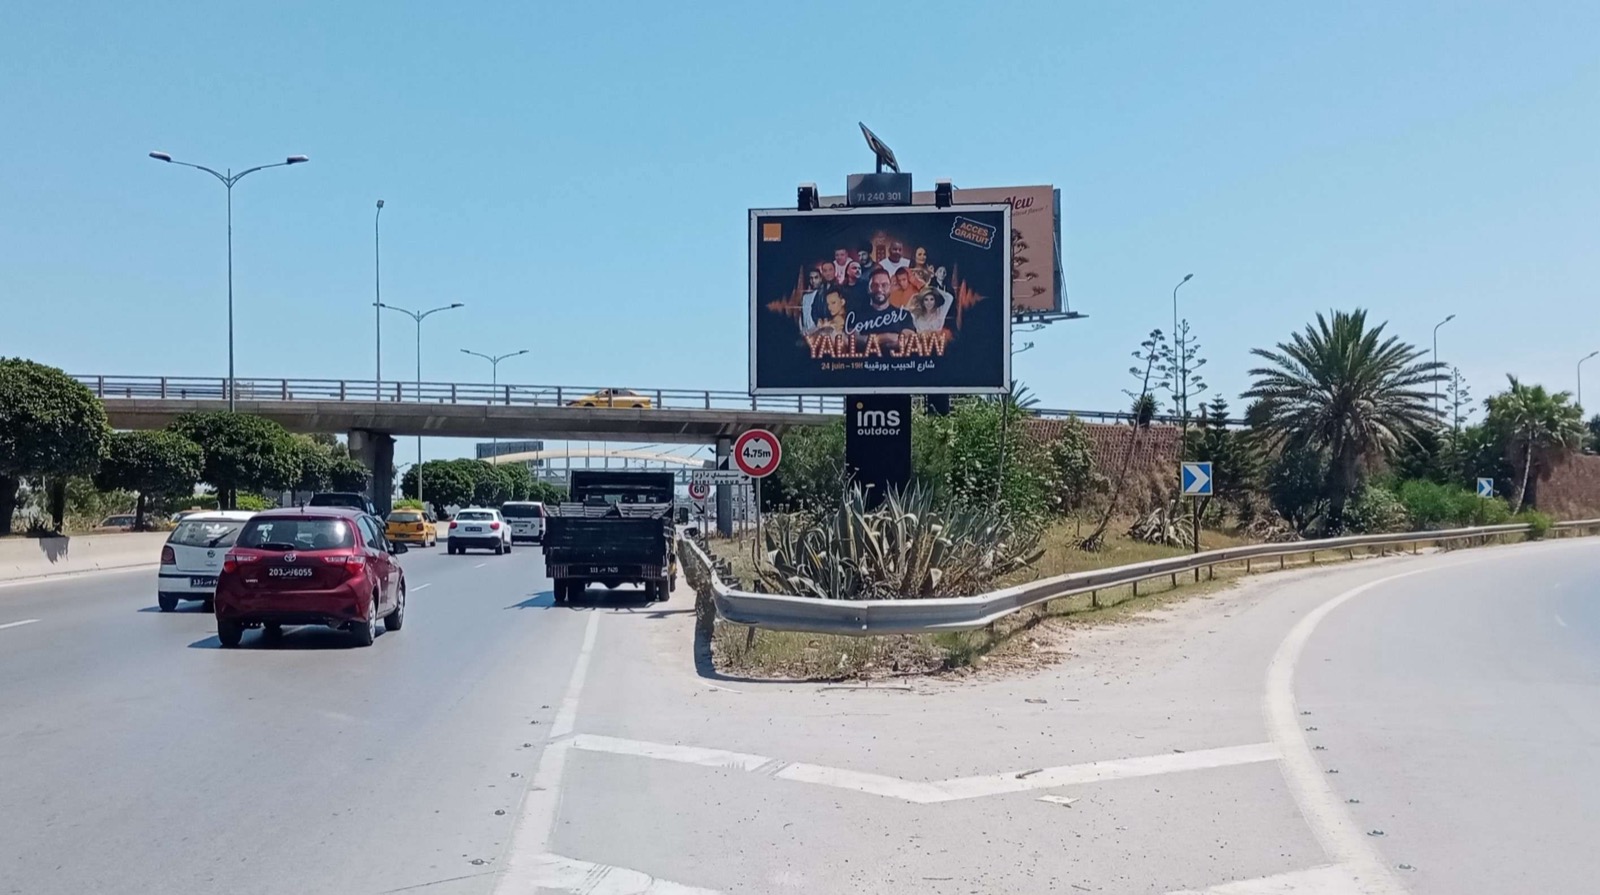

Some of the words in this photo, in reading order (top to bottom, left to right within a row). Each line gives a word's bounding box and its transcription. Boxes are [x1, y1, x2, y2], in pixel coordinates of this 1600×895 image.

[857, 193, 865, 202] 71
[867, 192, 885, 201] 240
[887, 192, 901, 201] 301
[960, 222, 989, 237] ACCES
[954, 228, 990, 245] GRATUIT
[845, 305, 907, 335] Concert
[804, 334, 883, 359] YALLA
[889, 332, 946, 358] JAW
[821, 362, 830, 370] 24
[831, 361, 845, 371] juin
[864, 361, 890, 371] بورقيبة
[891, 360, 915, 371] الحبيب
[917, 359, 935, 372] شارع
[856, 402, 900, 427] ims
[857, 427, 900, 435] outdoor
[743, 447, 771, 458] 4.75m
[694, 485, 705, 494] 60
[269, 568, 283, 576] 203
[293, 568, 313, 576] 6055
